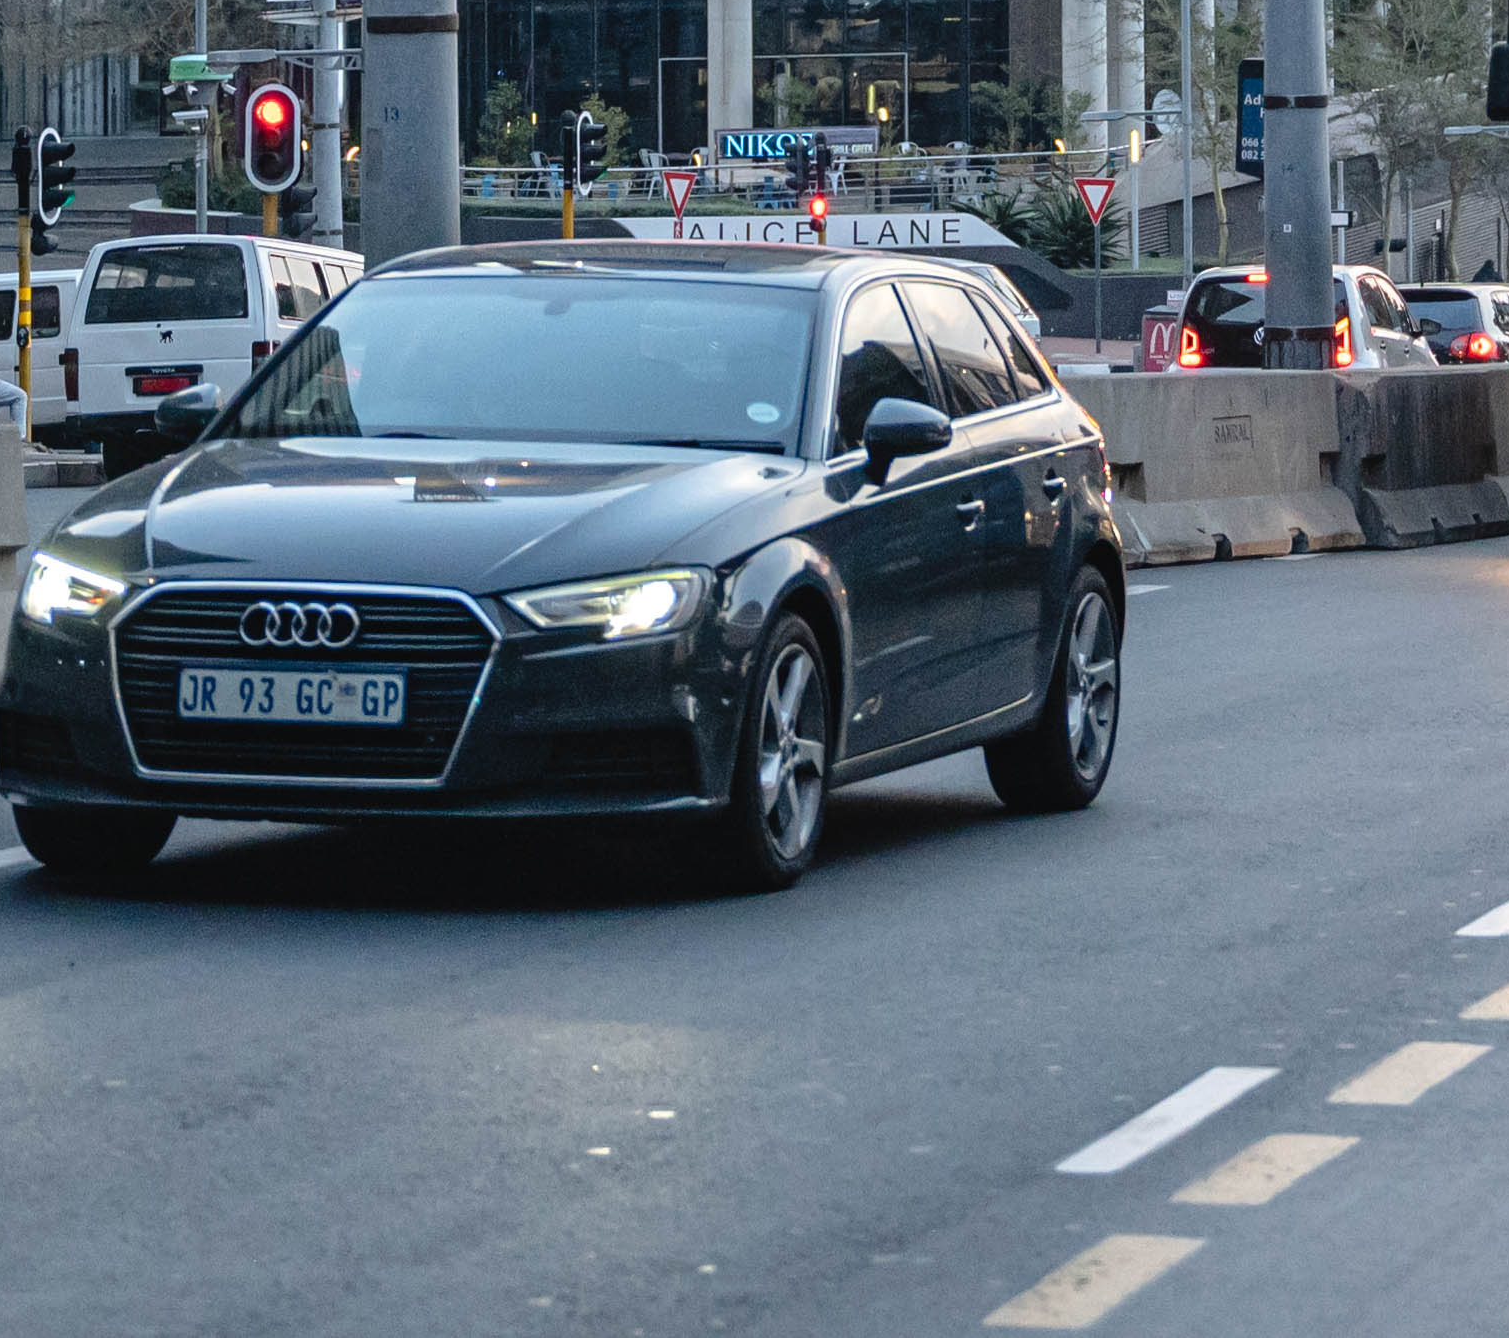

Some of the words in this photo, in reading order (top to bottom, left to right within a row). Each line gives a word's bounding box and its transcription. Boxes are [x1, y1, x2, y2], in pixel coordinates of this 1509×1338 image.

[1242, 138, 1259, 148] 066
[1242, 149, 1259, 160] 082
[853, 219, 961, 245] LANE
[183, 674, 217, 713] JR
[240, 676, 275, 714] 93
[297, 678, 334, 716] GC
[362, 679, 399, 717] GP
